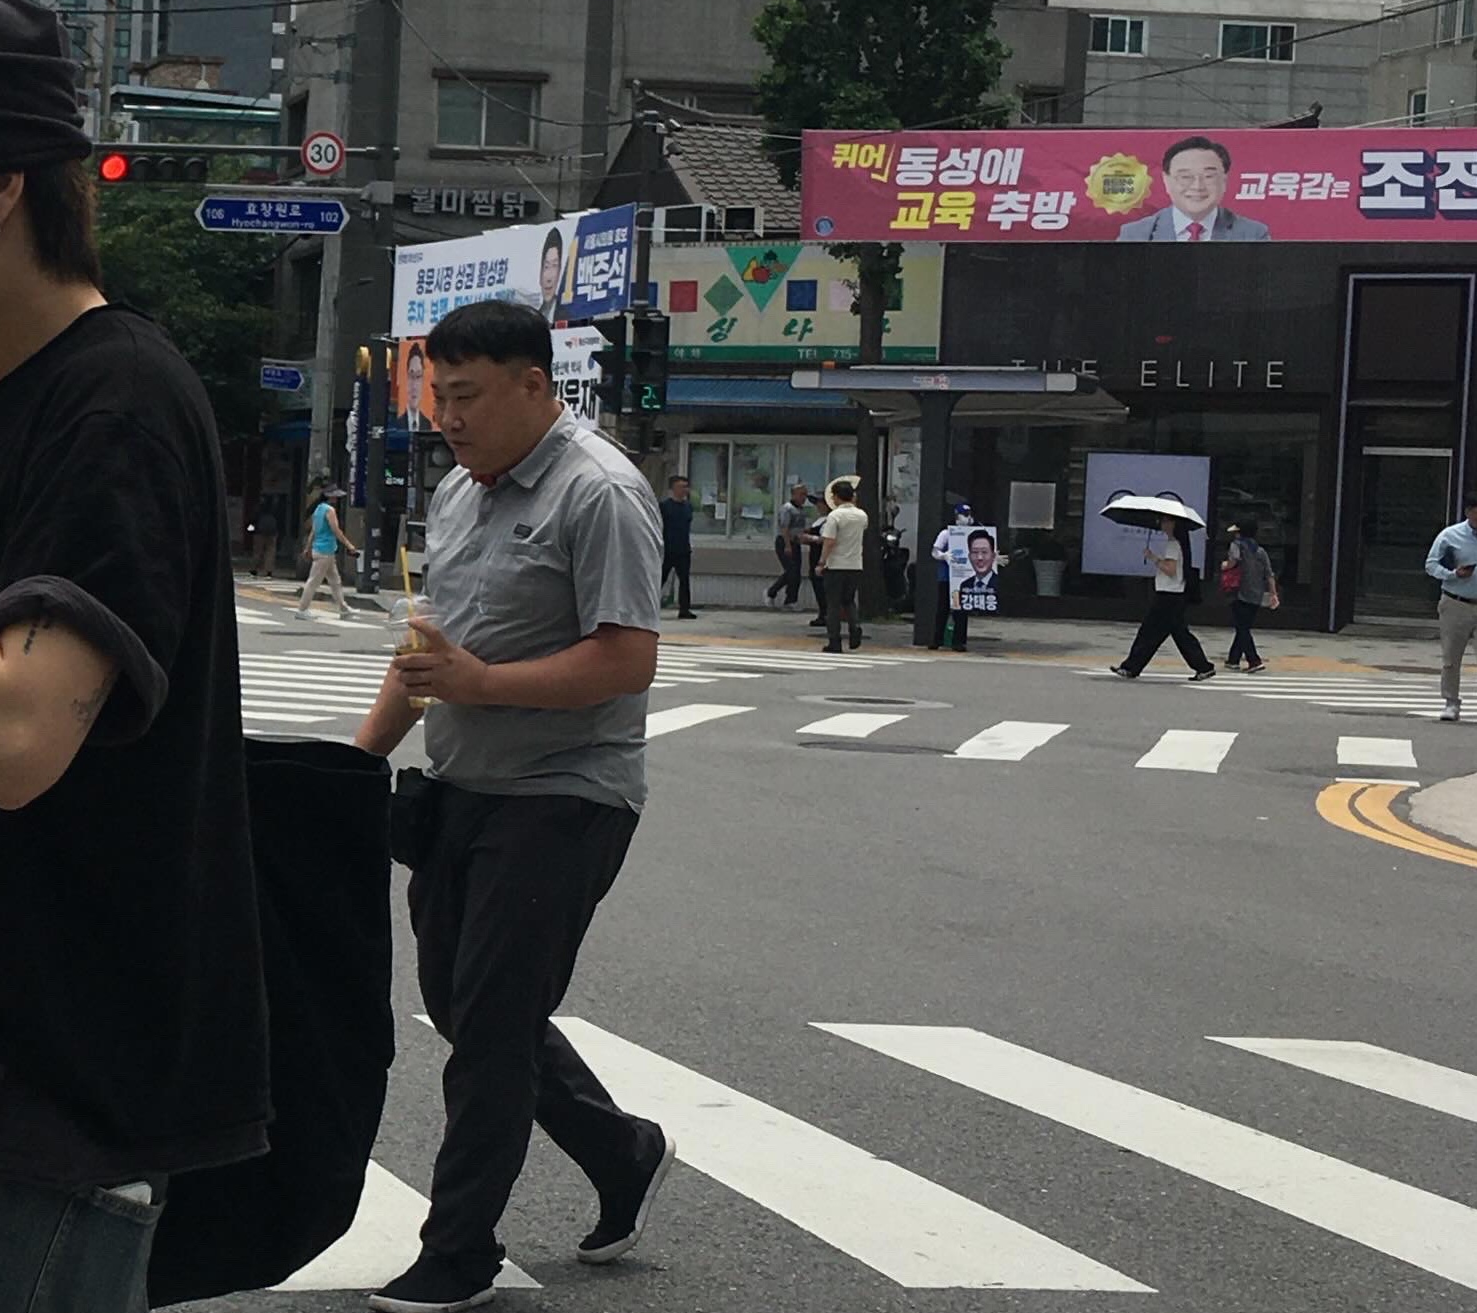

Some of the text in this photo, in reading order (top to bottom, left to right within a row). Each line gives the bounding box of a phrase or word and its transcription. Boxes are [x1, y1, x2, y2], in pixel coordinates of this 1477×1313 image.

[310, 144, 337, 163] 30
[832, 144, 1024, 186] 퀴어 동성애
[1235, 172, 1351, 201] 교육감은
[245, 202, 302, 218] 효창원로
[320, 212, 339, 223] 102
[411, 188, 524, 218] 월미찜닭
[889, 191, 1076, 230] 교육 추방
[232, 218, 315, 230] Hyochangwon-ro
[416, 257, 509, 296] 용문시장 상권 활성화
[577, 247, 627, 302] 백준석
[1140, 360, 1284, 388] ELITE
